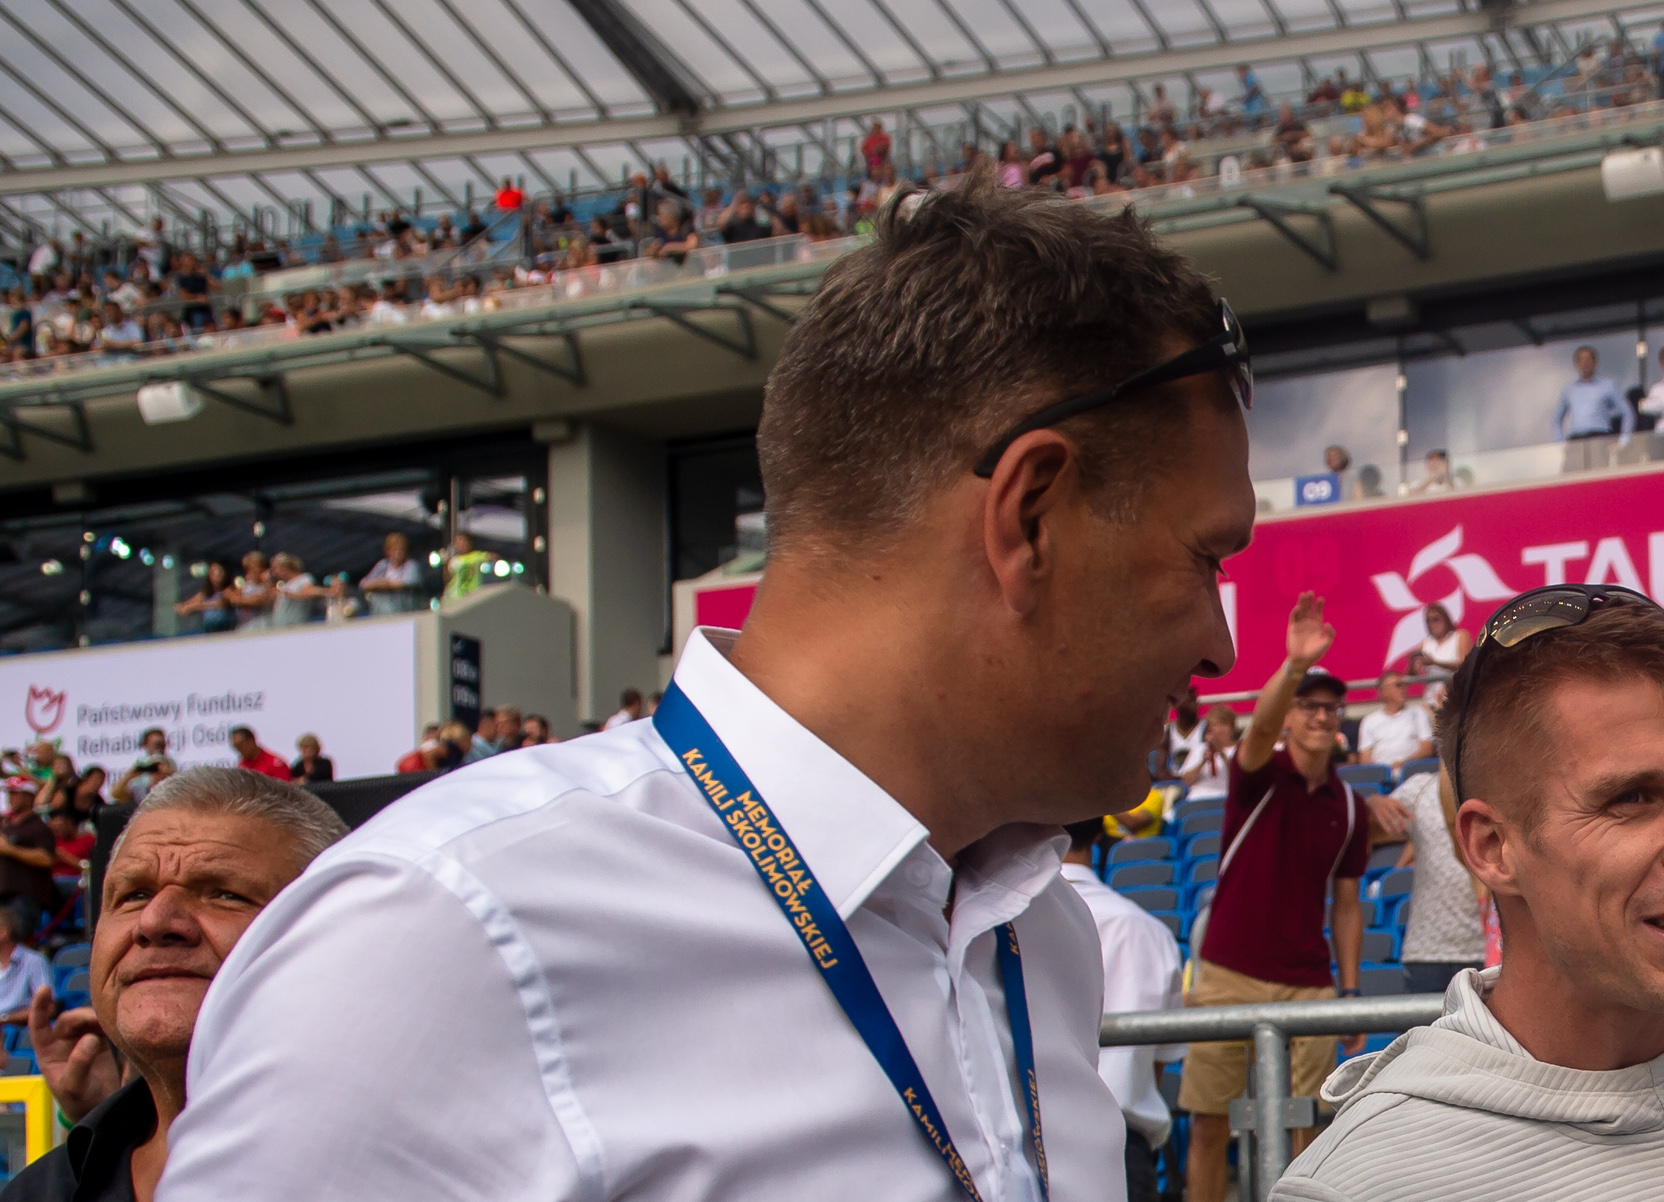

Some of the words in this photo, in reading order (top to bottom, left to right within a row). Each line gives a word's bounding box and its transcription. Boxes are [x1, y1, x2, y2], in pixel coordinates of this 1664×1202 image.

[1303, 480, 1332, 500] 09
[682, 748, 735, 811] KAMILI
[726, 810, 838, 969] SKOLIMOWSKIEJ
[736, 790, 813, 895] MEMORIAŁ
